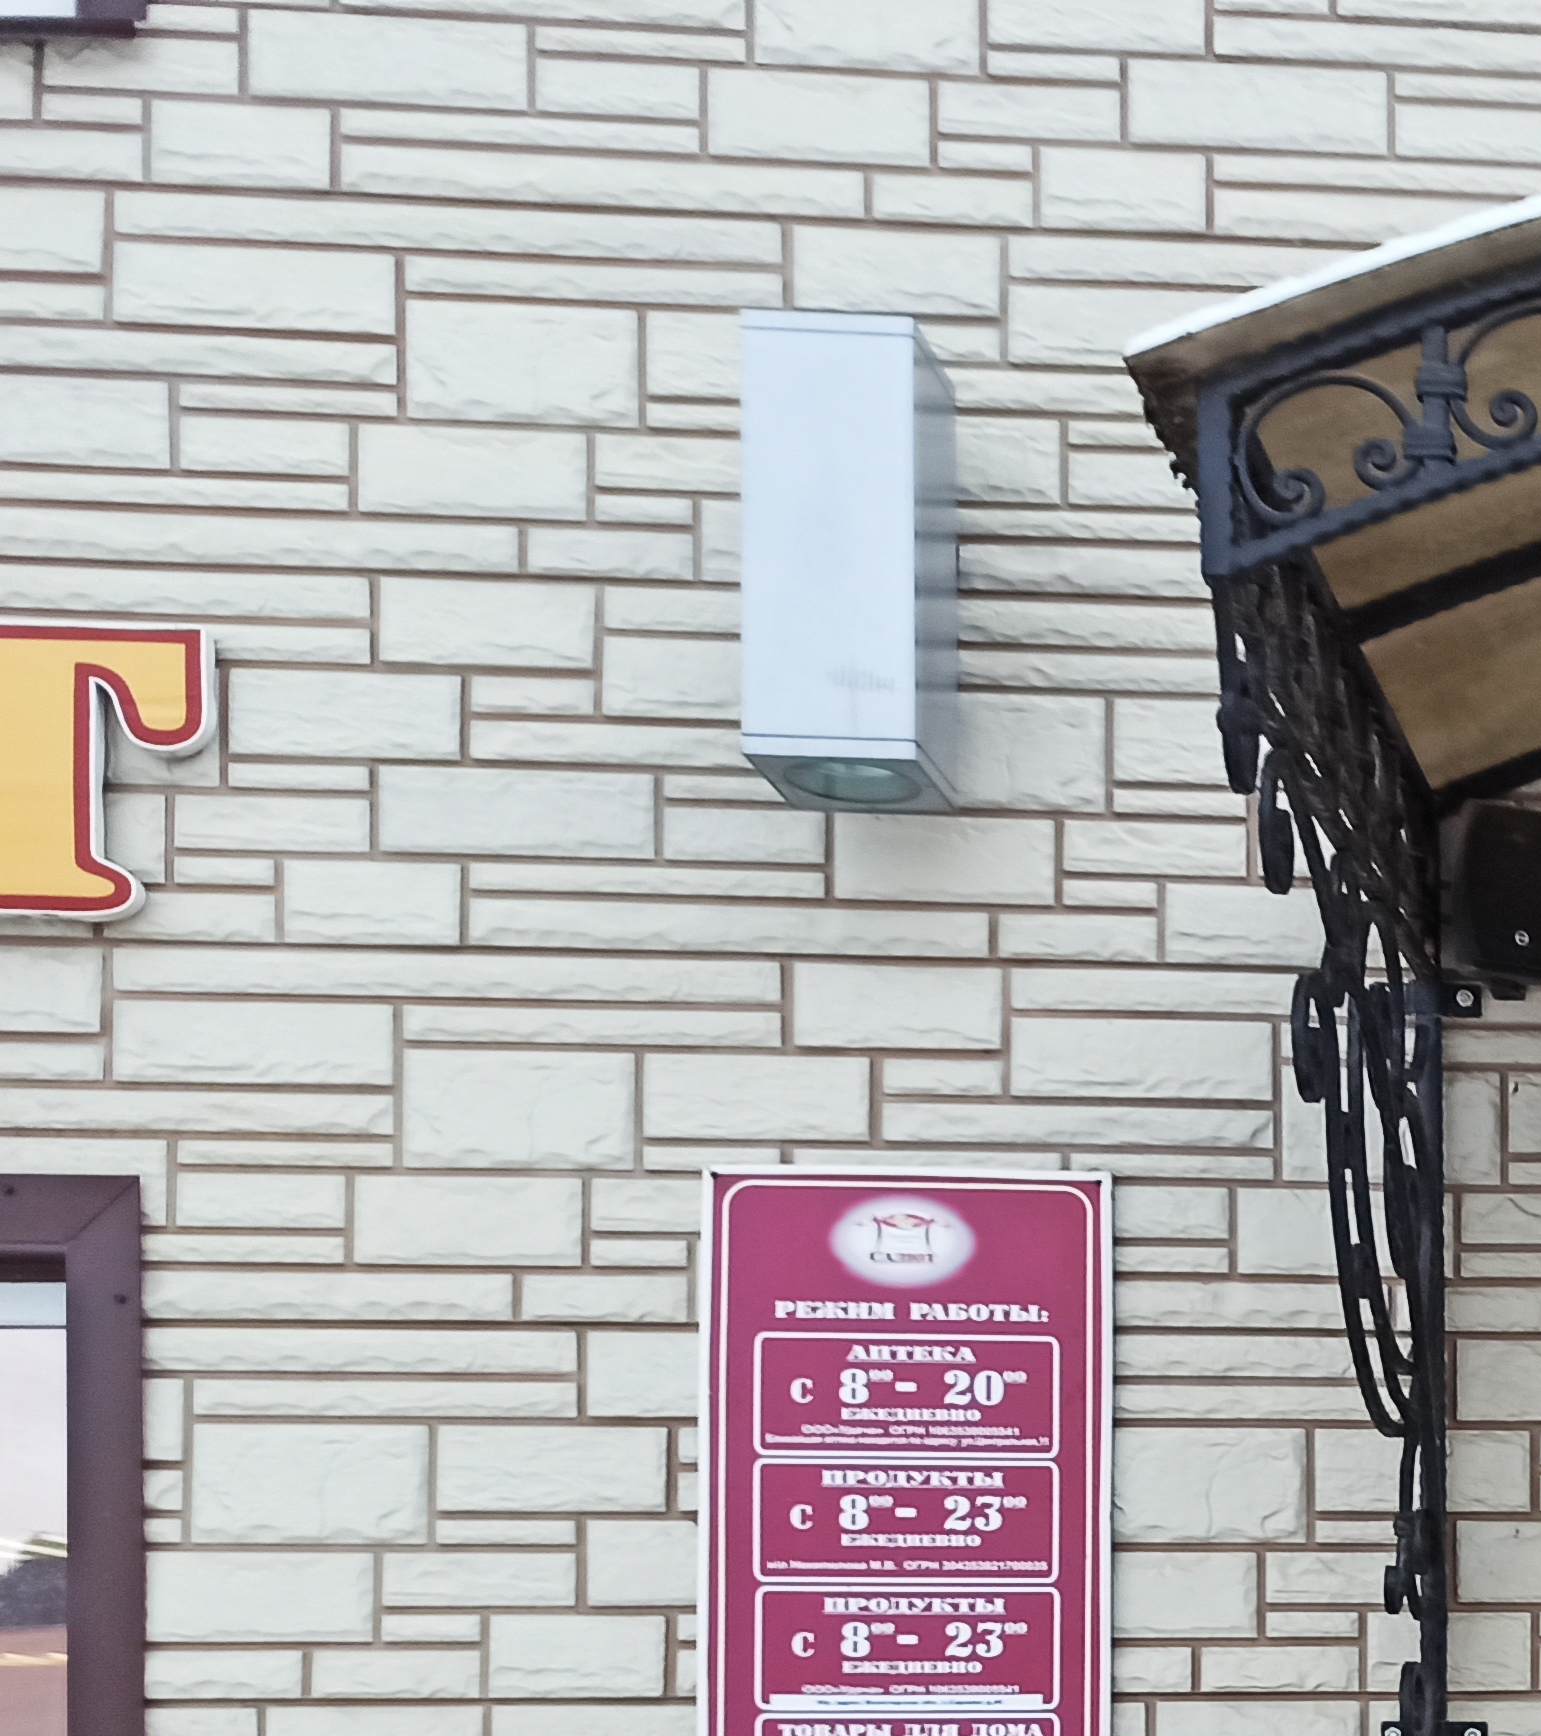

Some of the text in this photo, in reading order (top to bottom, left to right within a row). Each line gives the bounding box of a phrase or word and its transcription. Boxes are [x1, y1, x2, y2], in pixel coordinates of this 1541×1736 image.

[774, 1299, 1050, 1323] РЕЖИМ РАБОТЫ:
[846, 1345, 976, 1362] АПТЕКА
[840, 1407, 982, 1422] ЕЖЕДНЕВНО
[822, 1470, 1005, 1488] ПРОДУКТЫ
[823, 1597, 1006, 1615] ПРОДУКТЫ
